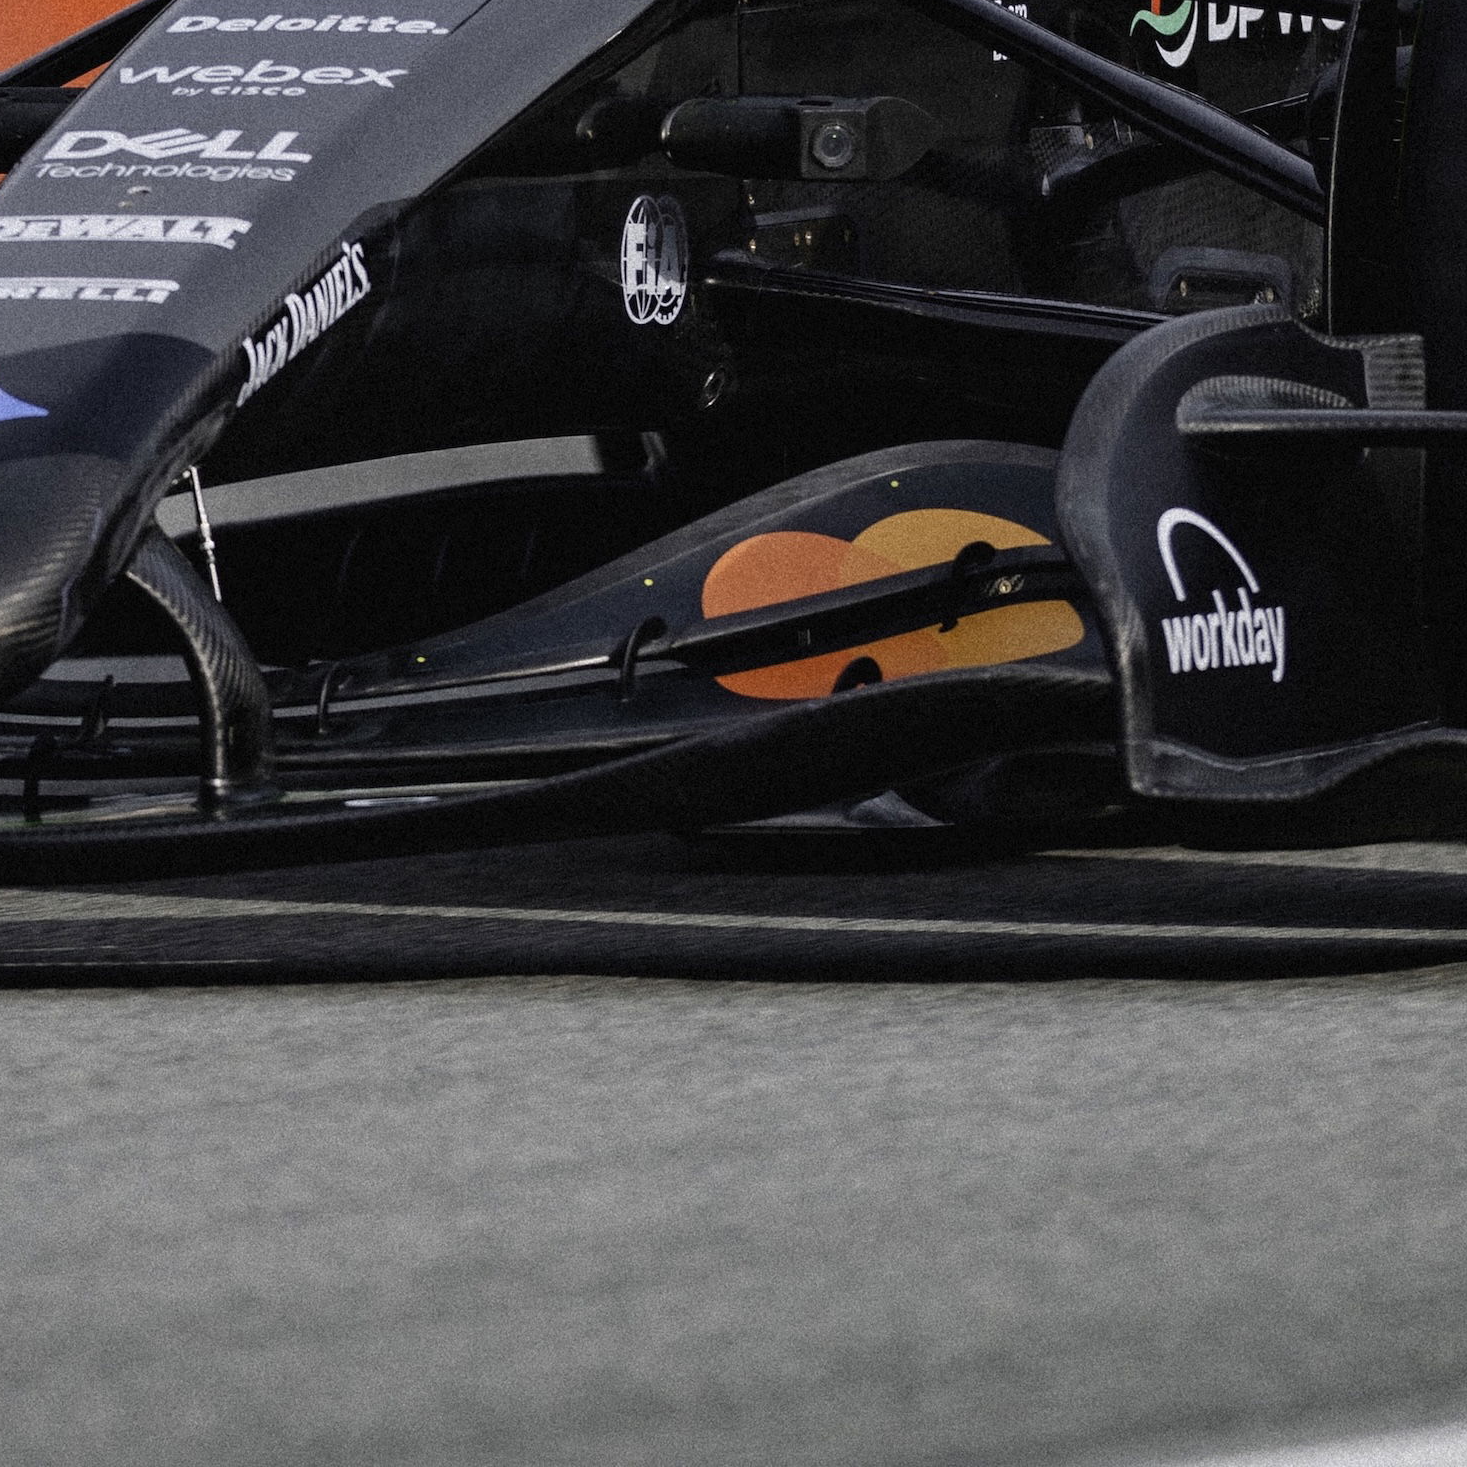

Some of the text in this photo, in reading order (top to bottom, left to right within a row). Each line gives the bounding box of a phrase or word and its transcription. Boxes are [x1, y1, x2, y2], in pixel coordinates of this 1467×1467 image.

[165, 15, 450, 35] Deloitte.
[119, 60, 408, 89] webex
[171, 87, 205, 97] by
[43, 128, 313, 163] DELL
[35, 161, 298, 182] Technologies
[284, 240, 372, 362] DANIEL'S
[1161, 586, 1285, 683] workday
